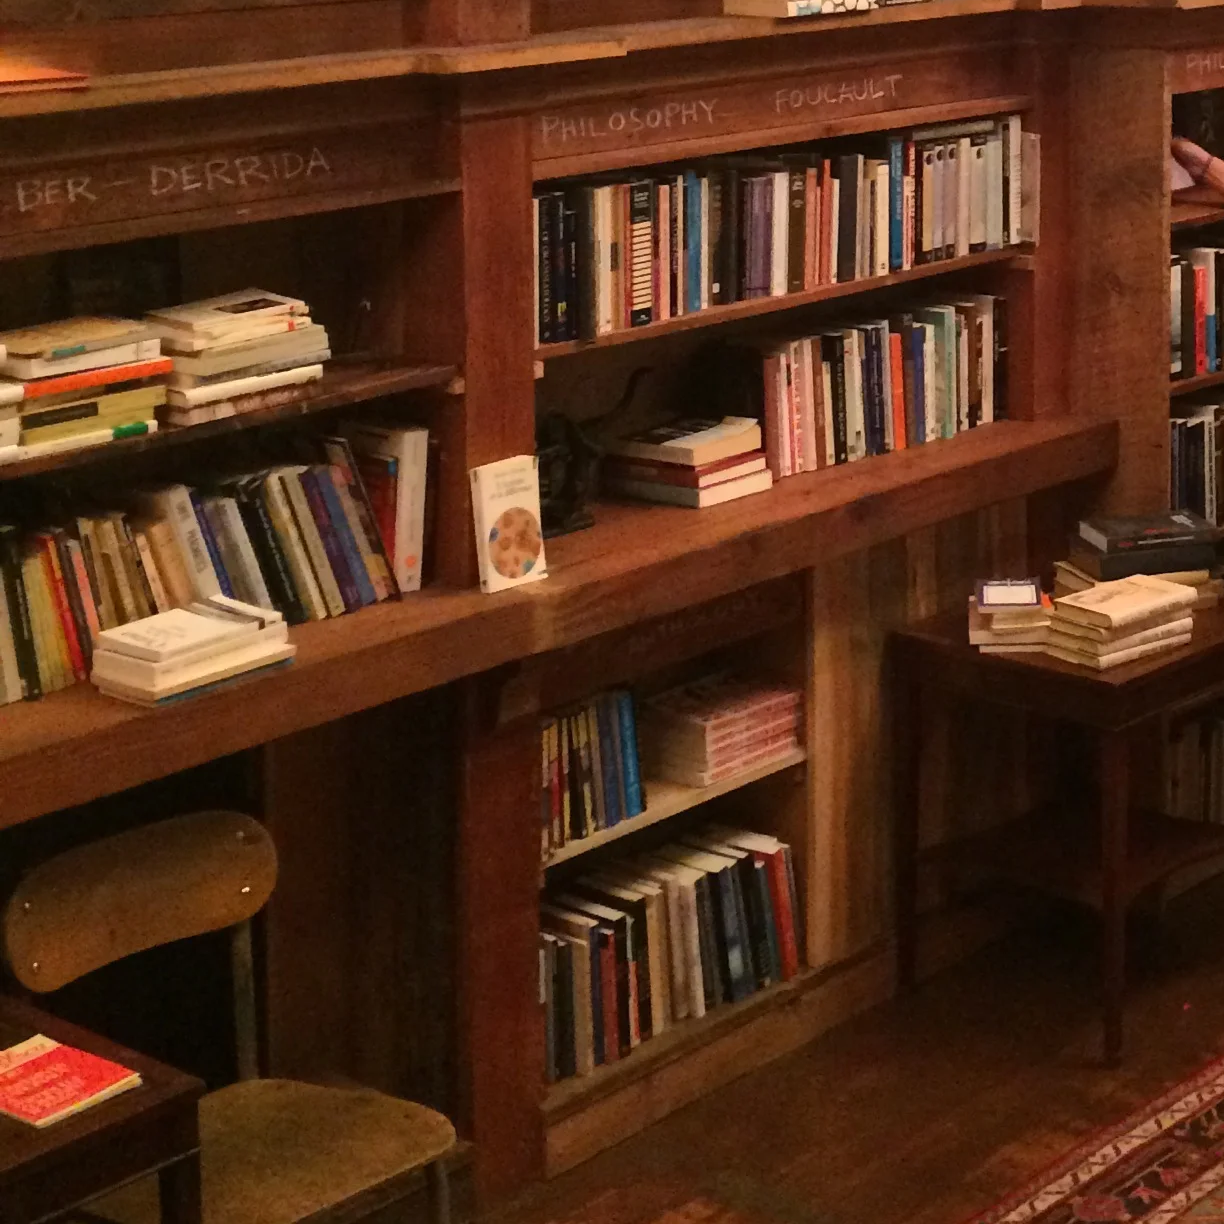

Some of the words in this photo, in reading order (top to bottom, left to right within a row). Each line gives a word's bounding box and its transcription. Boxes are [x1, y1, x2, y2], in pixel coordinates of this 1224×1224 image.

[539, 98, 719, 144] PHILOSOPHY
[775, 74, 903, 114] FOUCAULT
[16, 176, 98, 212] BER
[151, 147, 331, 196] DERRIDA
